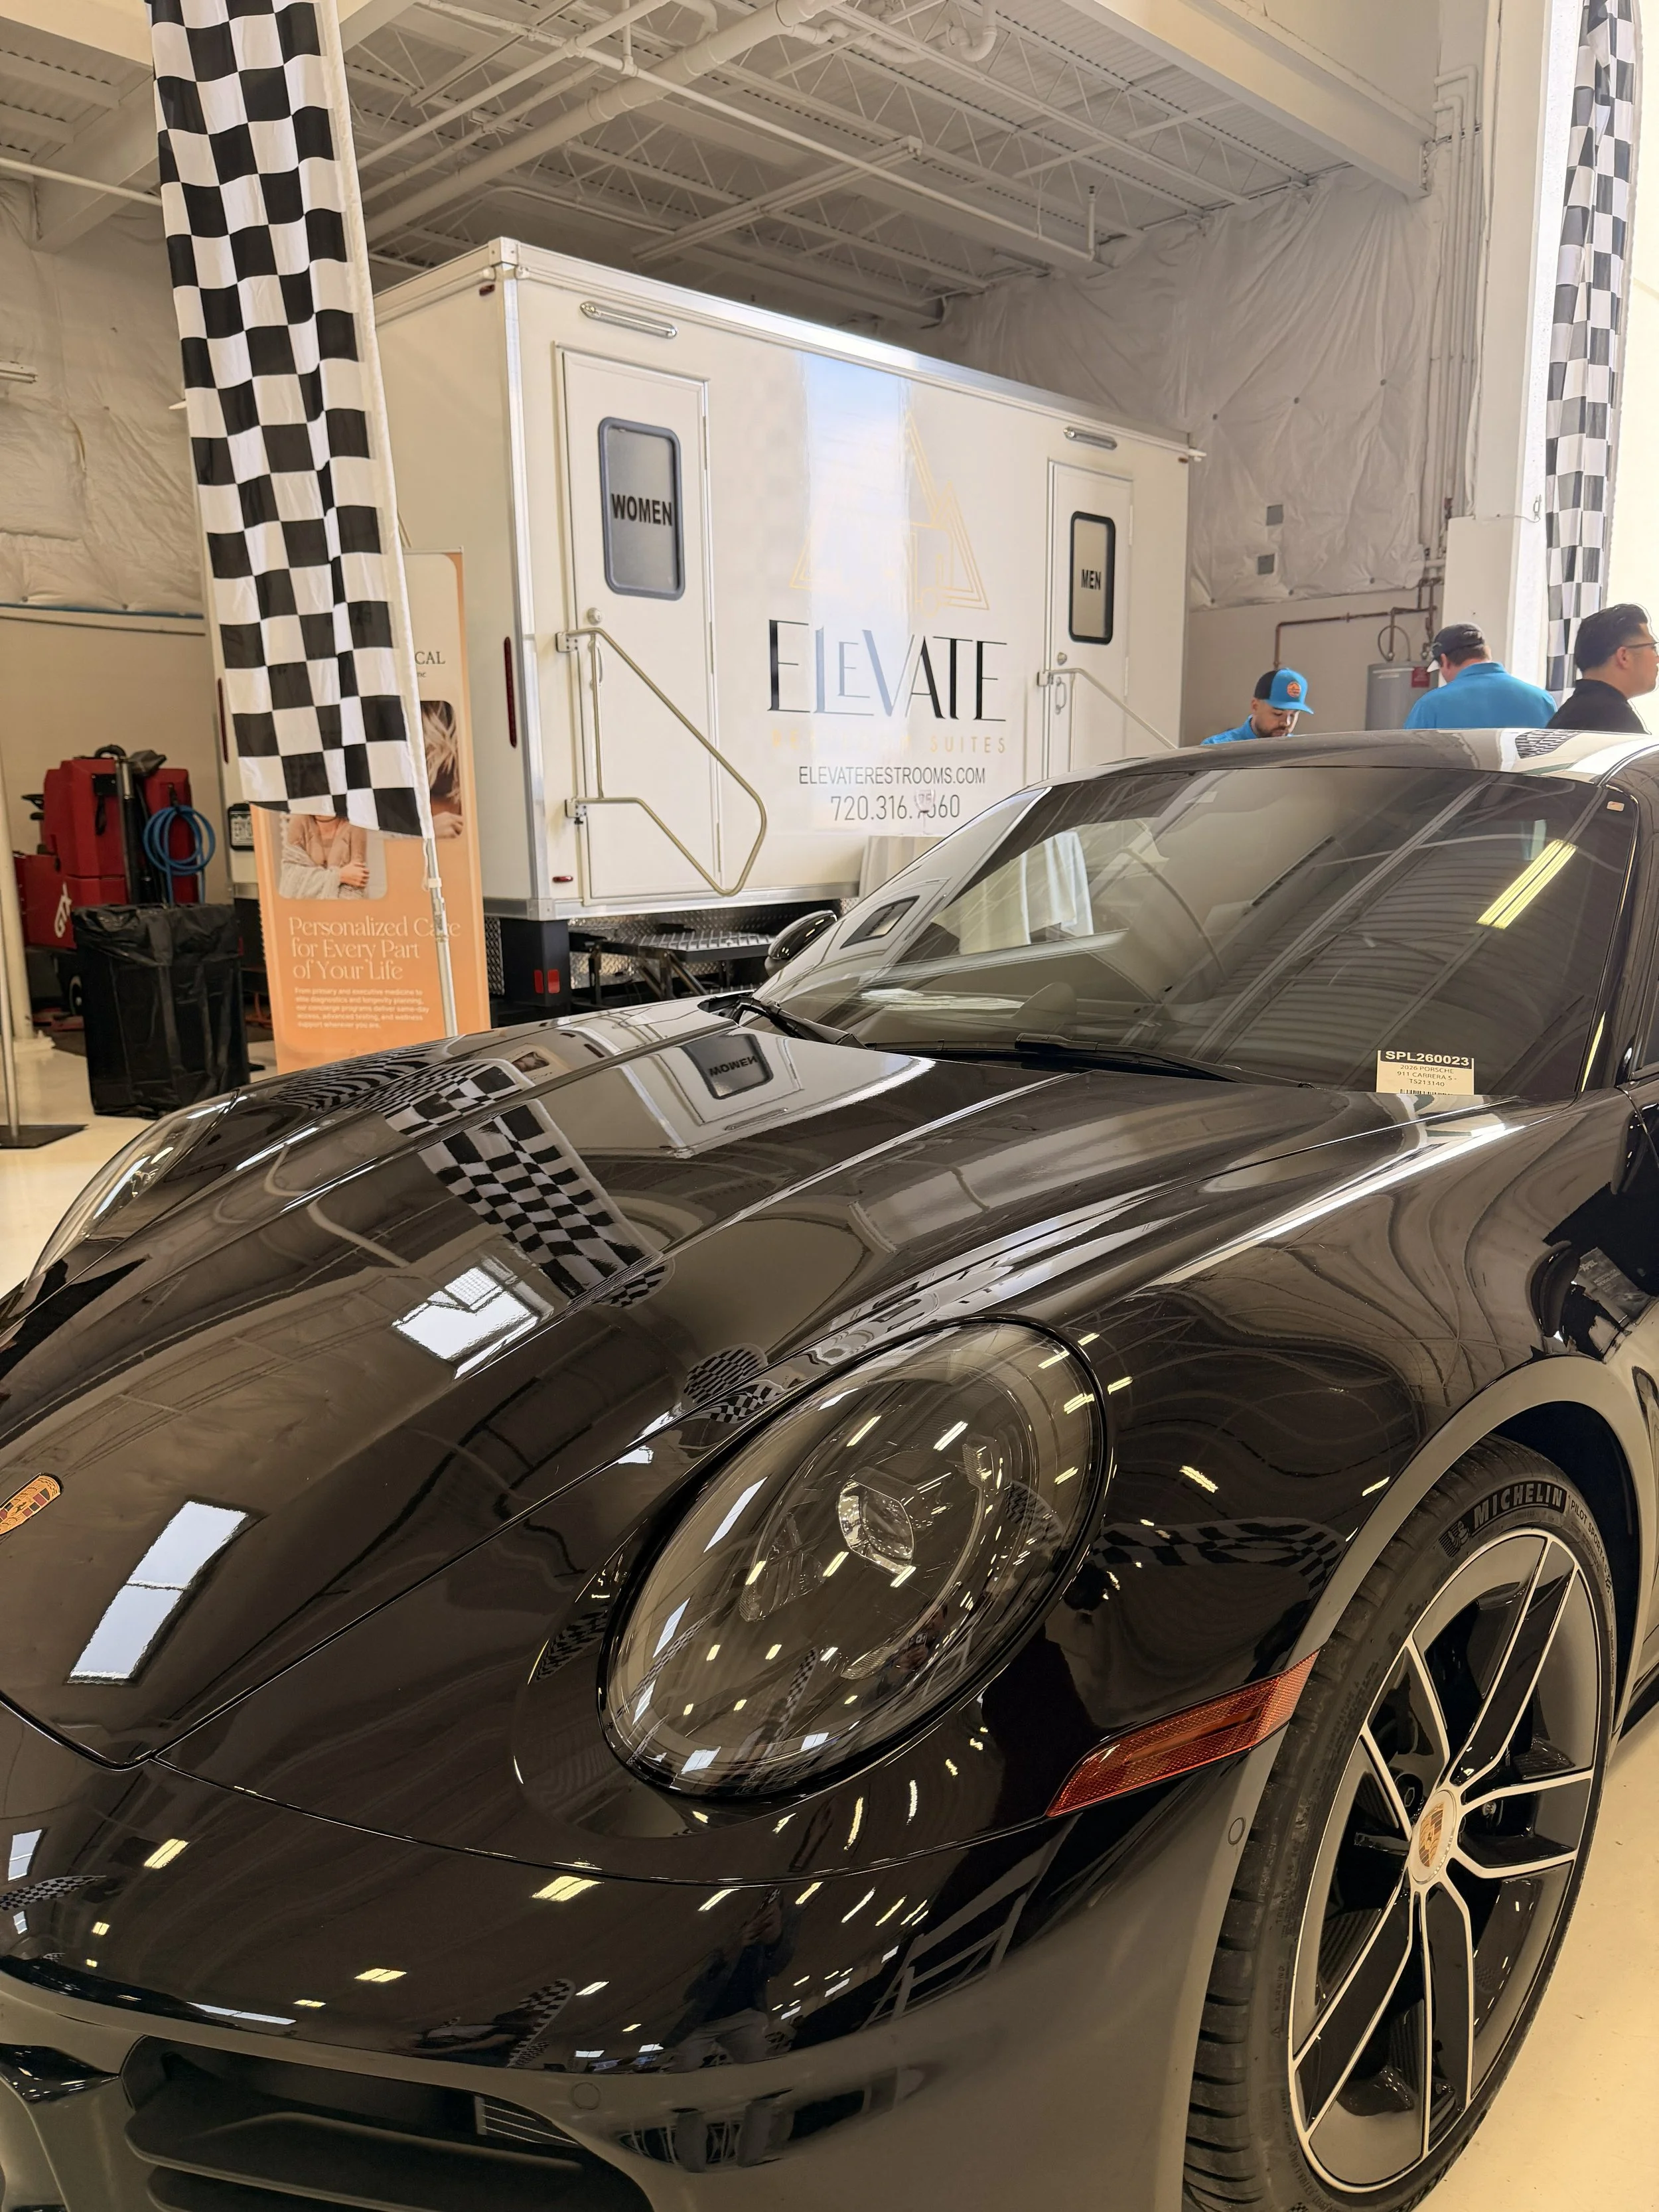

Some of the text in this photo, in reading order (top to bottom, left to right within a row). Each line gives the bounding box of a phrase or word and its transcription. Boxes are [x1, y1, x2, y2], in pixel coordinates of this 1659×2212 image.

[611, 493, 672, 526] WOMEN
[1081, 569, 1102, 590] MEN
[767, 619, 1007, 721] ELEVATE
[930, 736, 1006, 754] SUITES
[799, 767, 986, 784] ELEVATERESTROOMS.COM
[289, 915, 409, 936] Personalized
[292, 936, 420, 962] for Every Part
[293, 960, 403, 980] of Your Life
[1385, 1051, 1469, 1066] SPL260023
[1473, 1483, 1563, 1529] MICHELIN
[1571, 1500, 1587, 1524] PILOT
[1588, 1523, 1603, 1557] SPORT
